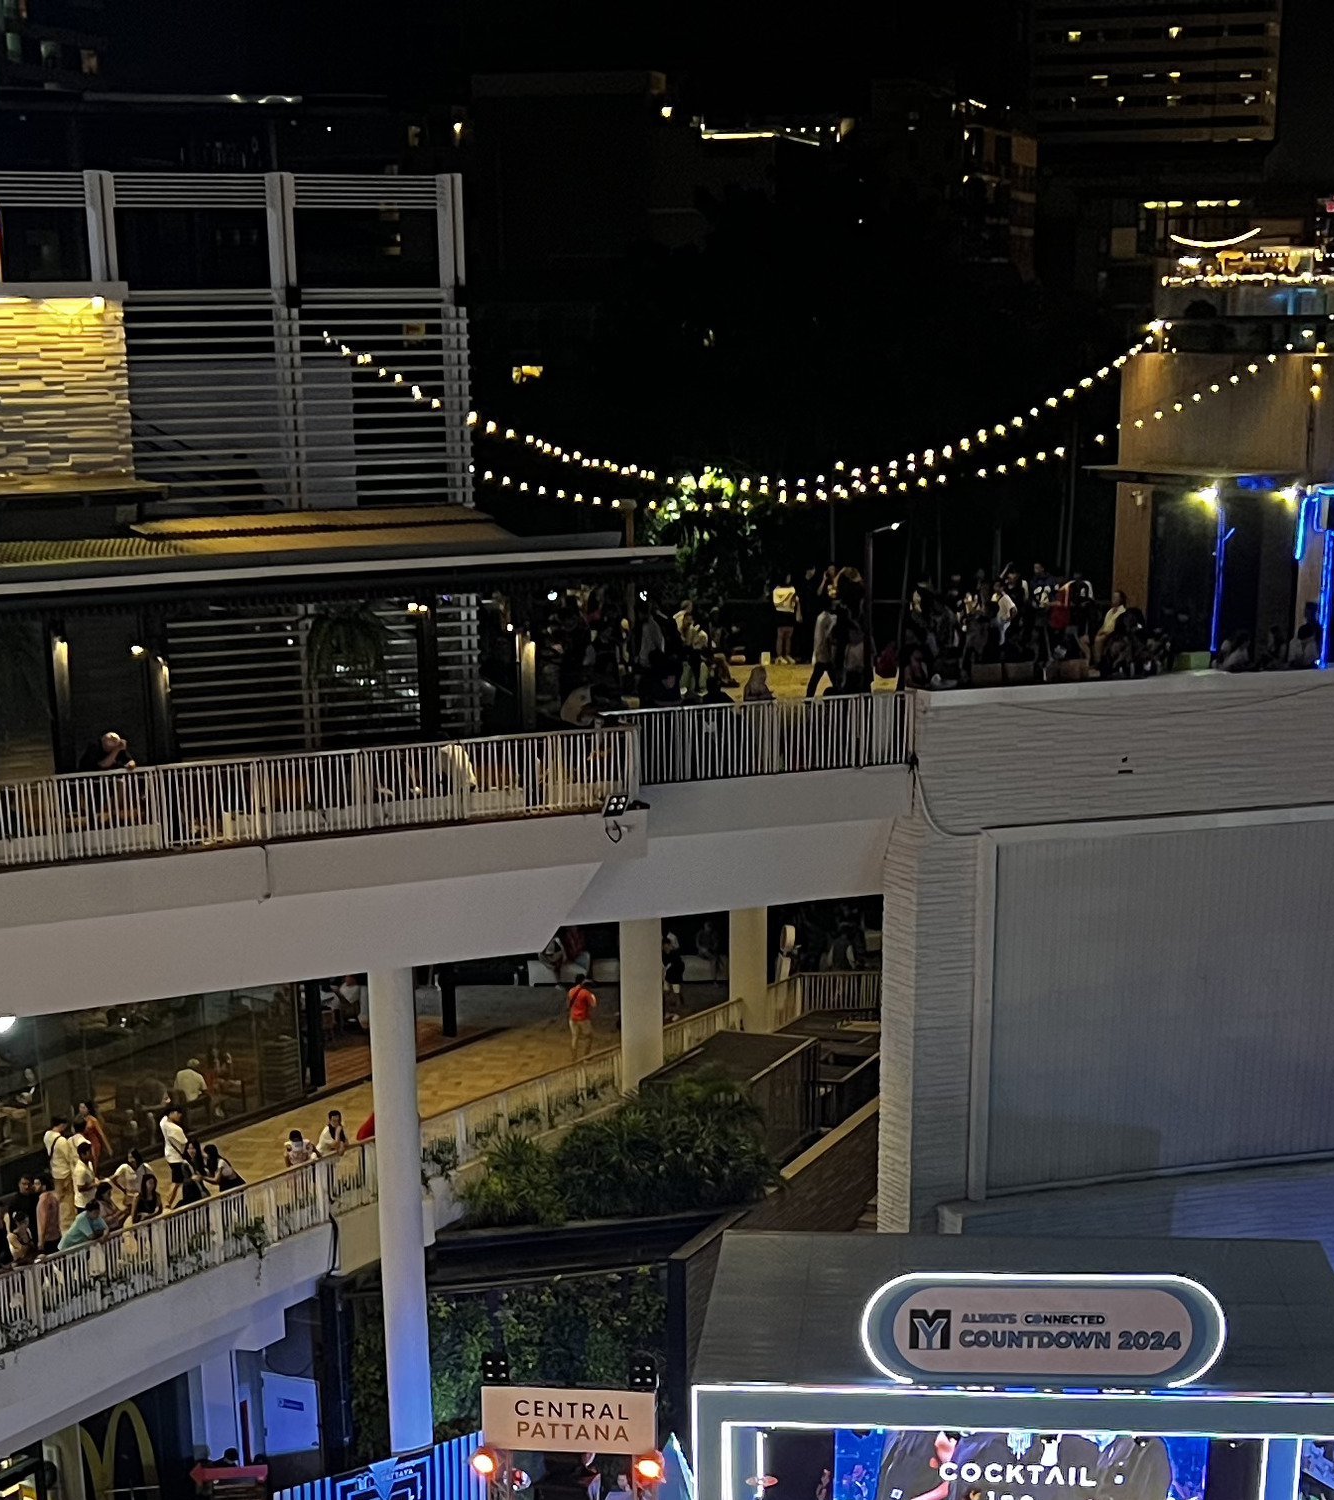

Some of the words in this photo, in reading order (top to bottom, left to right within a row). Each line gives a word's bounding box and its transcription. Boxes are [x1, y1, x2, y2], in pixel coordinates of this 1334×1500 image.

[960, 1312, 1017, 1325] ALWAYS
[1024, 1313, 1107, 1326] CONNECTED
[958, 1330, 1111, 1350] COUNTDOWN
[1117, 1330, 1181, 1351] 2024
[514, 1400, 630, 1421] CENTRAL
[517, 1421, 630, 1442] PATTANA
[938, 1461, 1098, 1488] COCKTAIL
